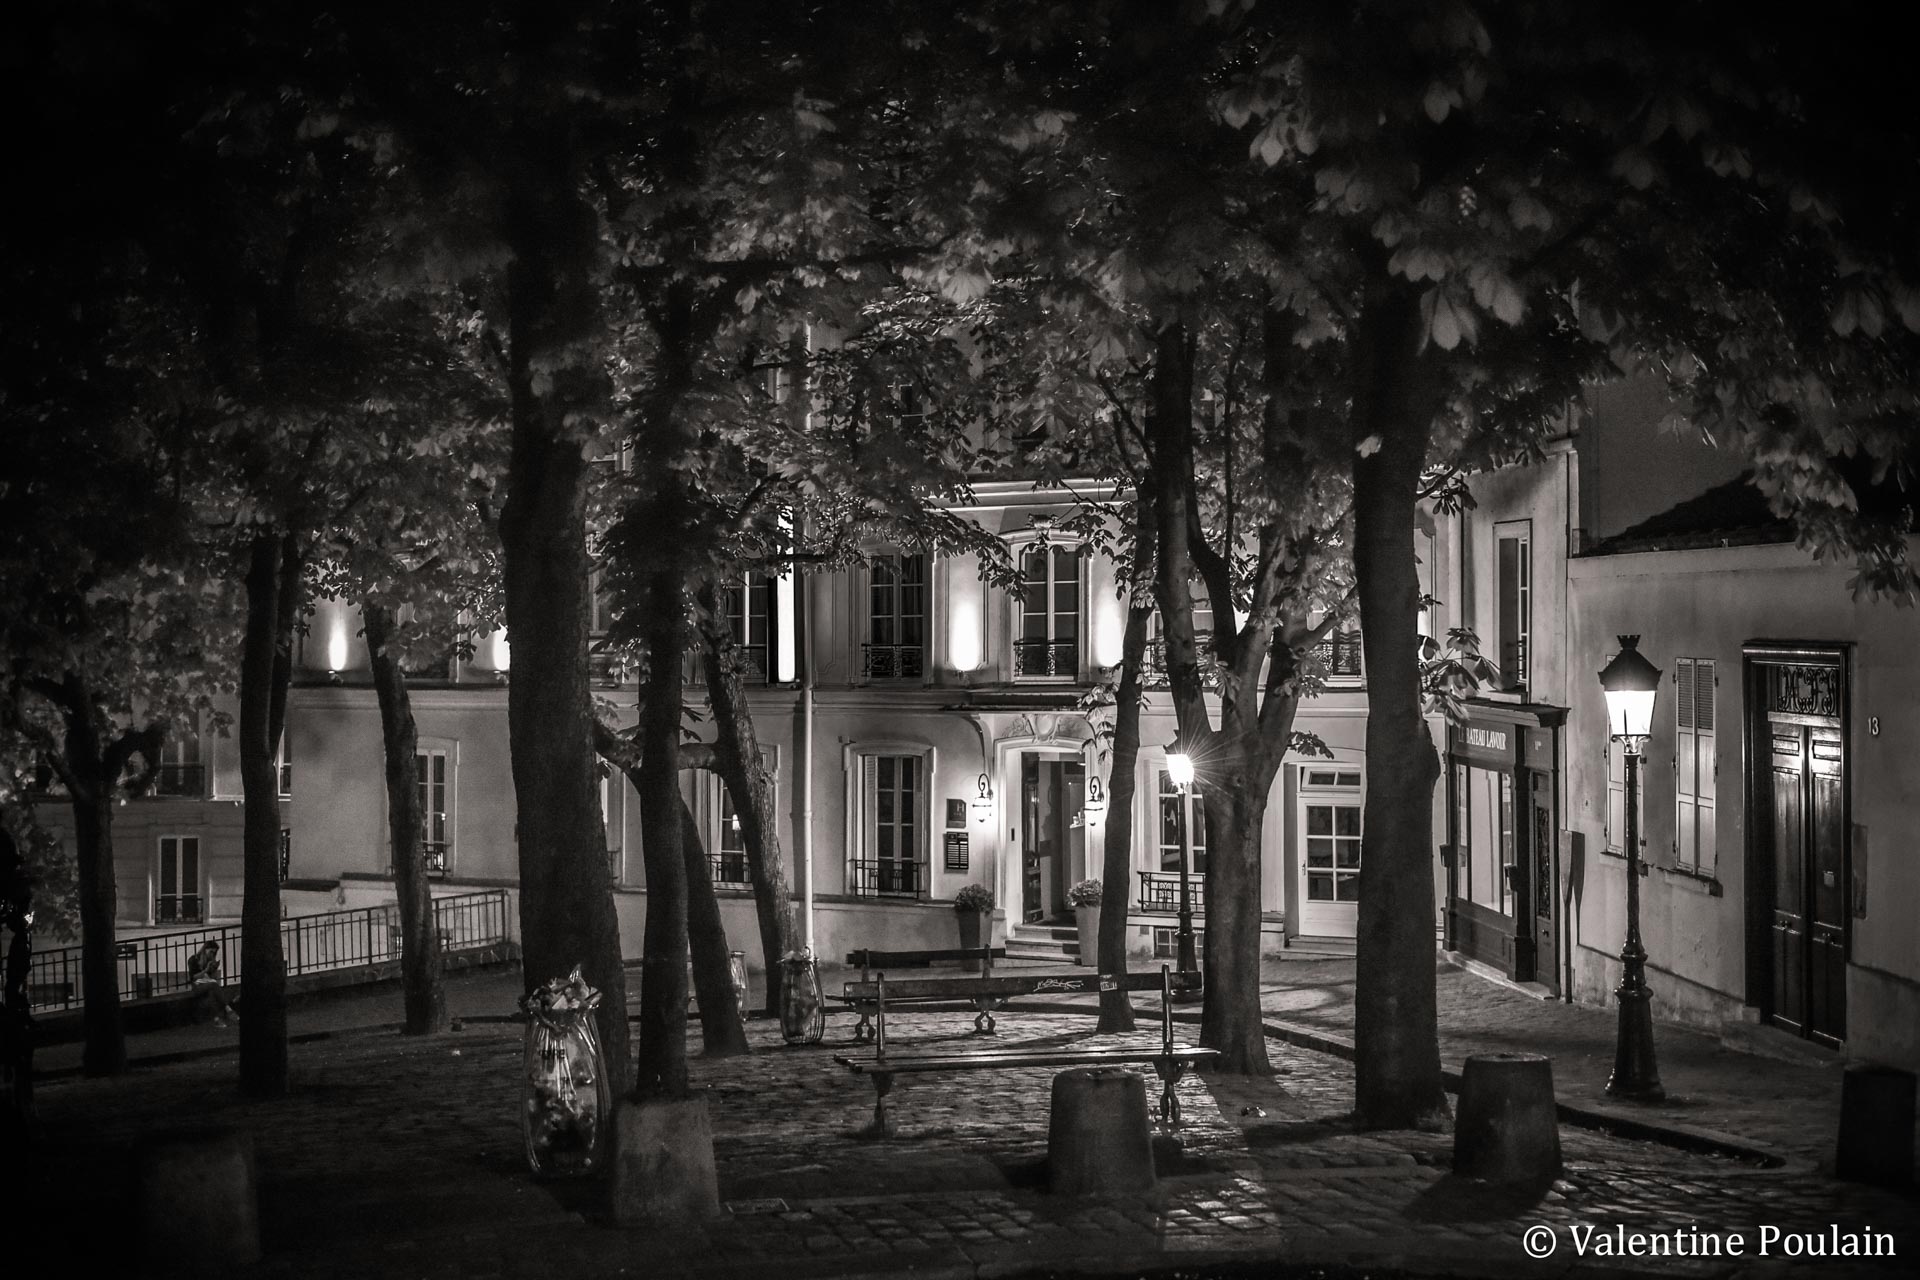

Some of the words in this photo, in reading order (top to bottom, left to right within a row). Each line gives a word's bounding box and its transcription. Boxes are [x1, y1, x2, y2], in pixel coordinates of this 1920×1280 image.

[1867, 716, 1879, 735] 13
[1466, 727, 1486, 746] BATEAU
[1486, 730, 1506, 750] LAVOIR
